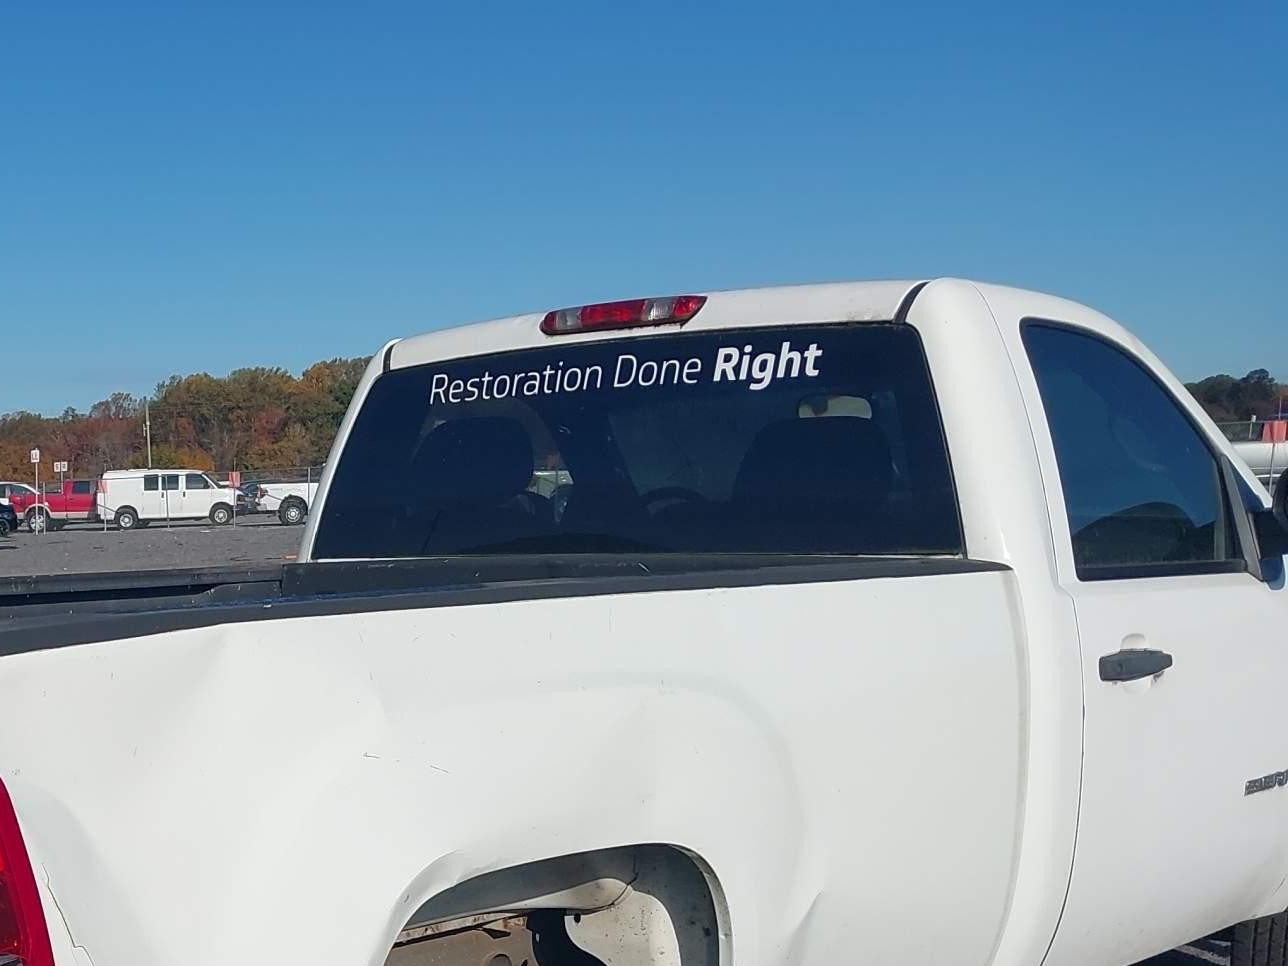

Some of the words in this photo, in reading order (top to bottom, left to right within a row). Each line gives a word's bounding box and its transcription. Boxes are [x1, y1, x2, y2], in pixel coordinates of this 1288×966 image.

[428, 360, 602, 405] Restoration
[613, 354, 702, 388] Done
[713, 342, 823, 391] Right
